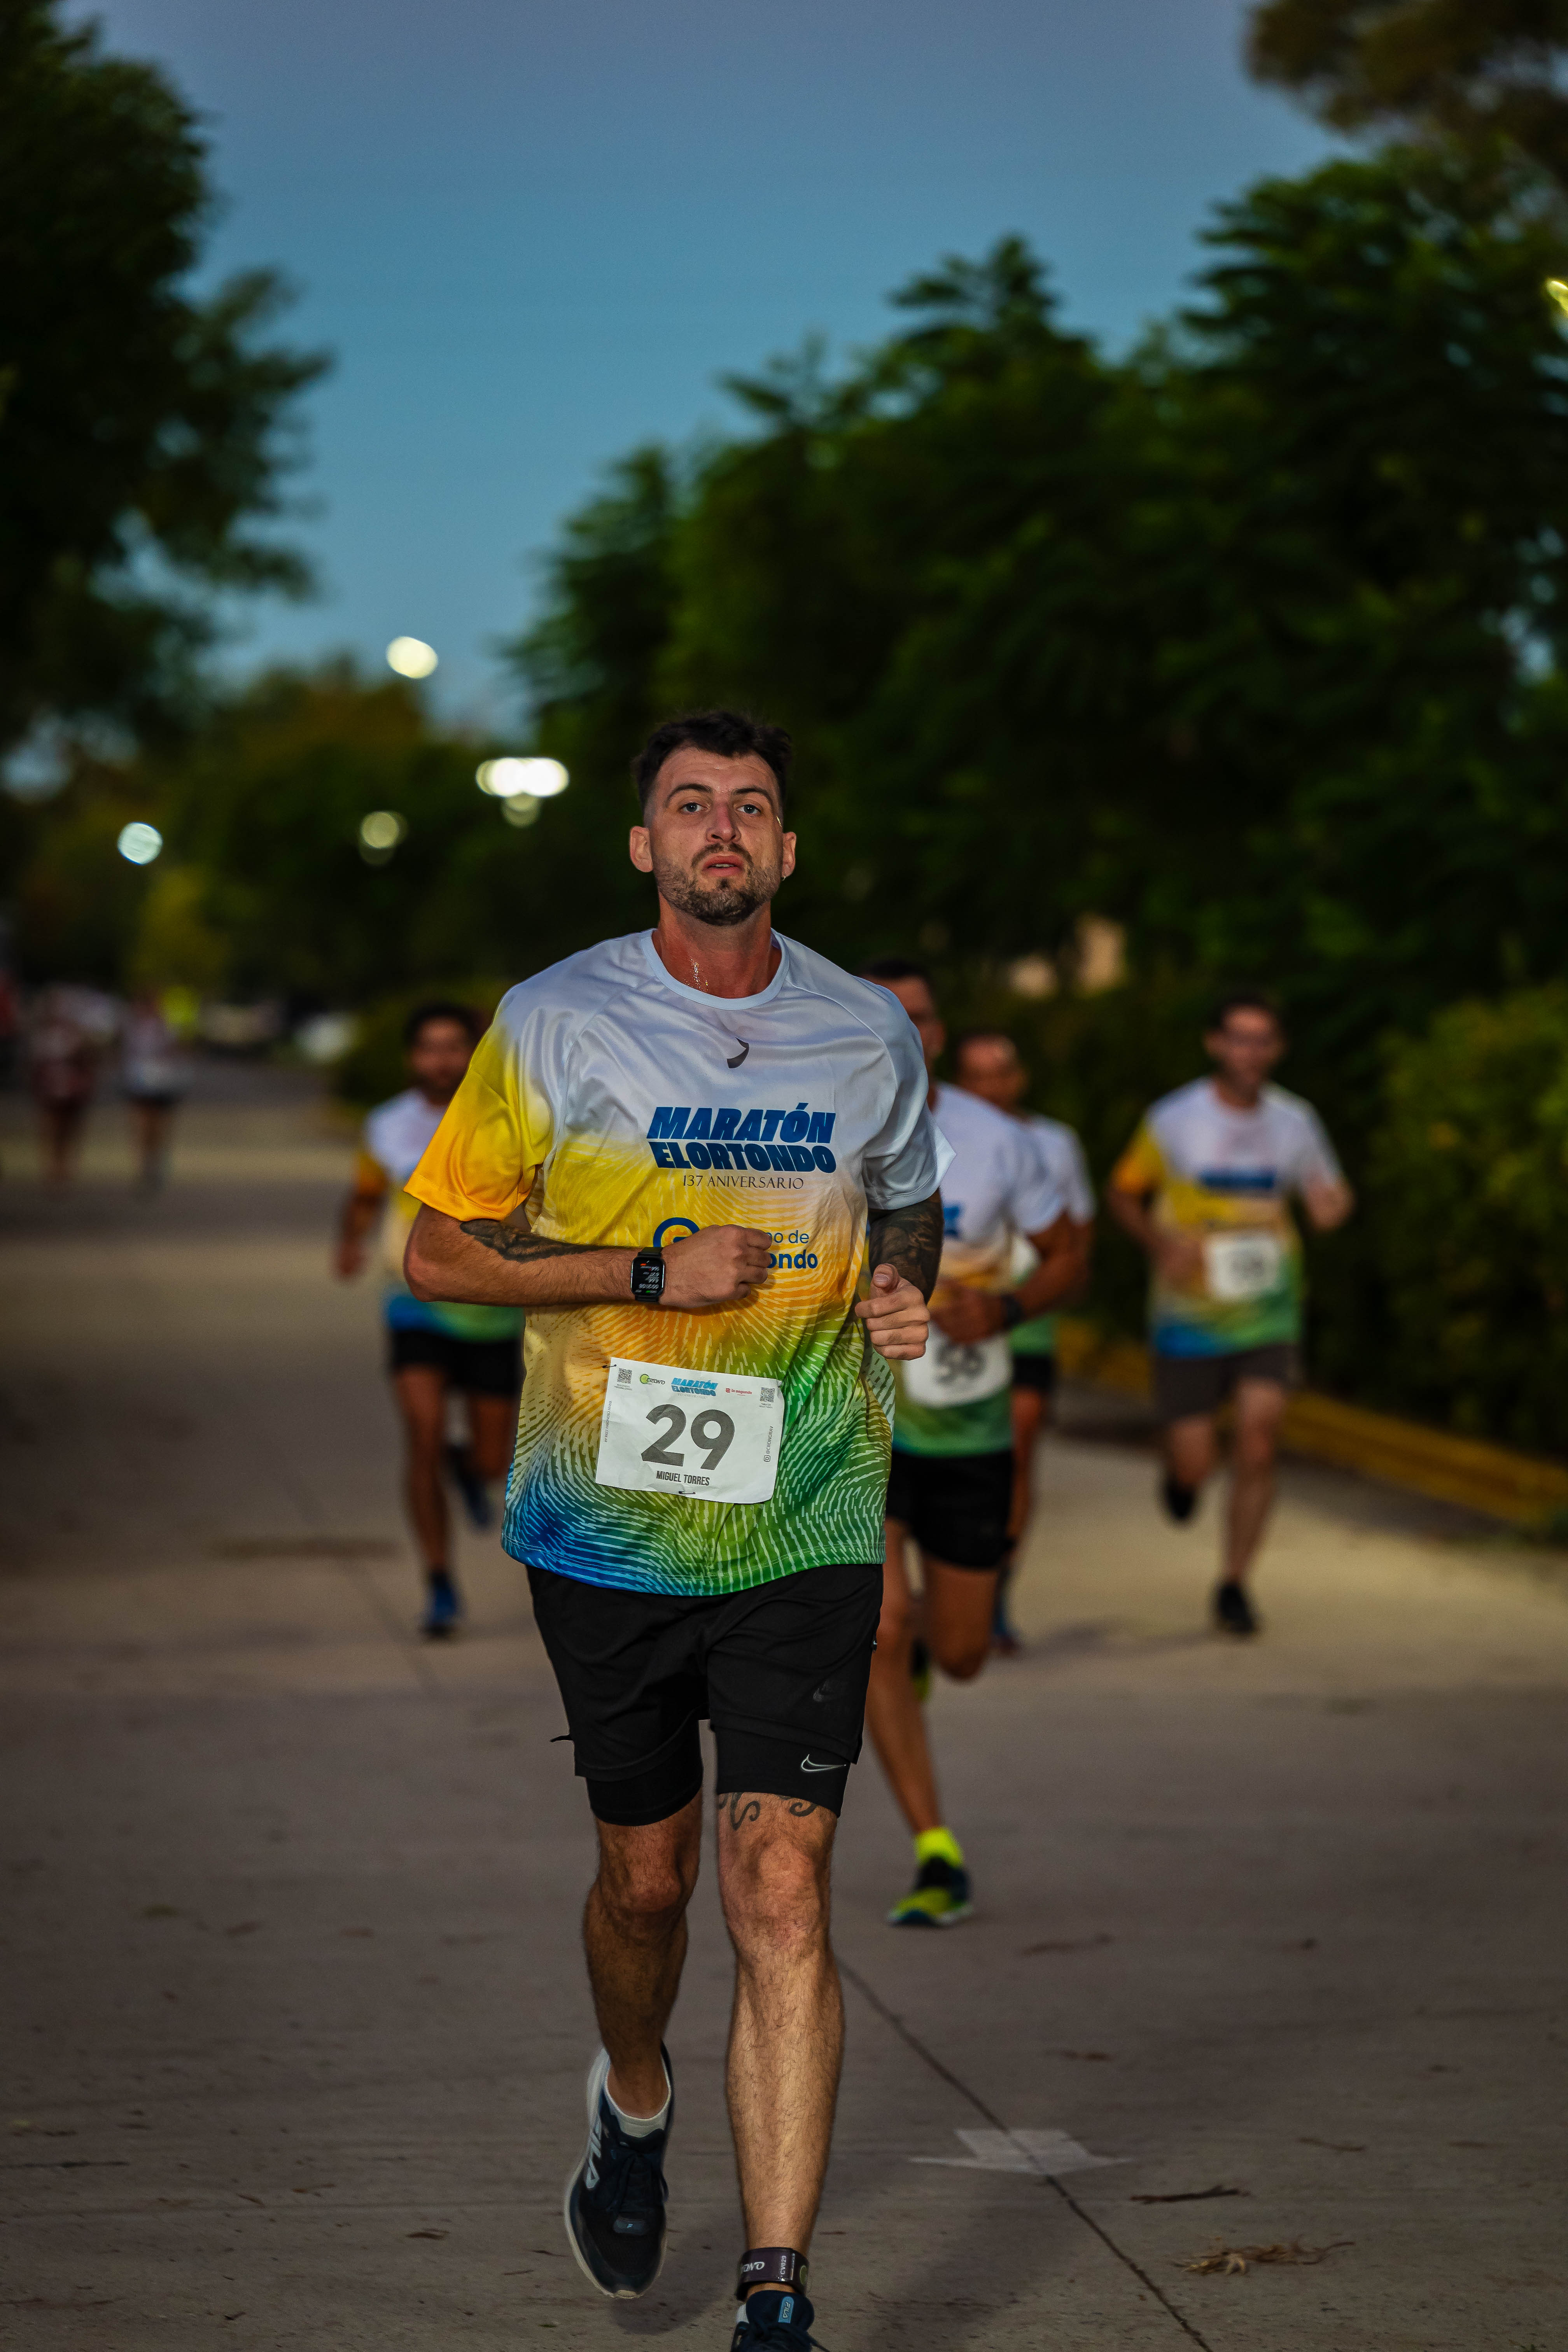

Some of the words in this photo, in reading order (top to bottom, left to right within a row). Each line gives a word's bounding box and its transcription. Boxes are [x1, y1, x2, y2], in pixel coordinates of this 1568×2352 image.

[646, 1102, 836, 1144] MARATÓN
[648, 1142, 837, 1174] ELORTONDO
[683, 1175, 703, 1187] 137
[707, 1176, 804, 1189] ANIVERSARIO
[788, 1230, 809, 1244] de
[671, 1377, 718, 1390] MARATÓN
[671, 1385, 716, 1396] ELORTONDO
[641, 1404, 735, 1470] 29
[656, 1470, 681, 1482] MIGUEL
[684, 1474, 710, 1486] TORRES
[782, 2301, 791, 2319] FILA
